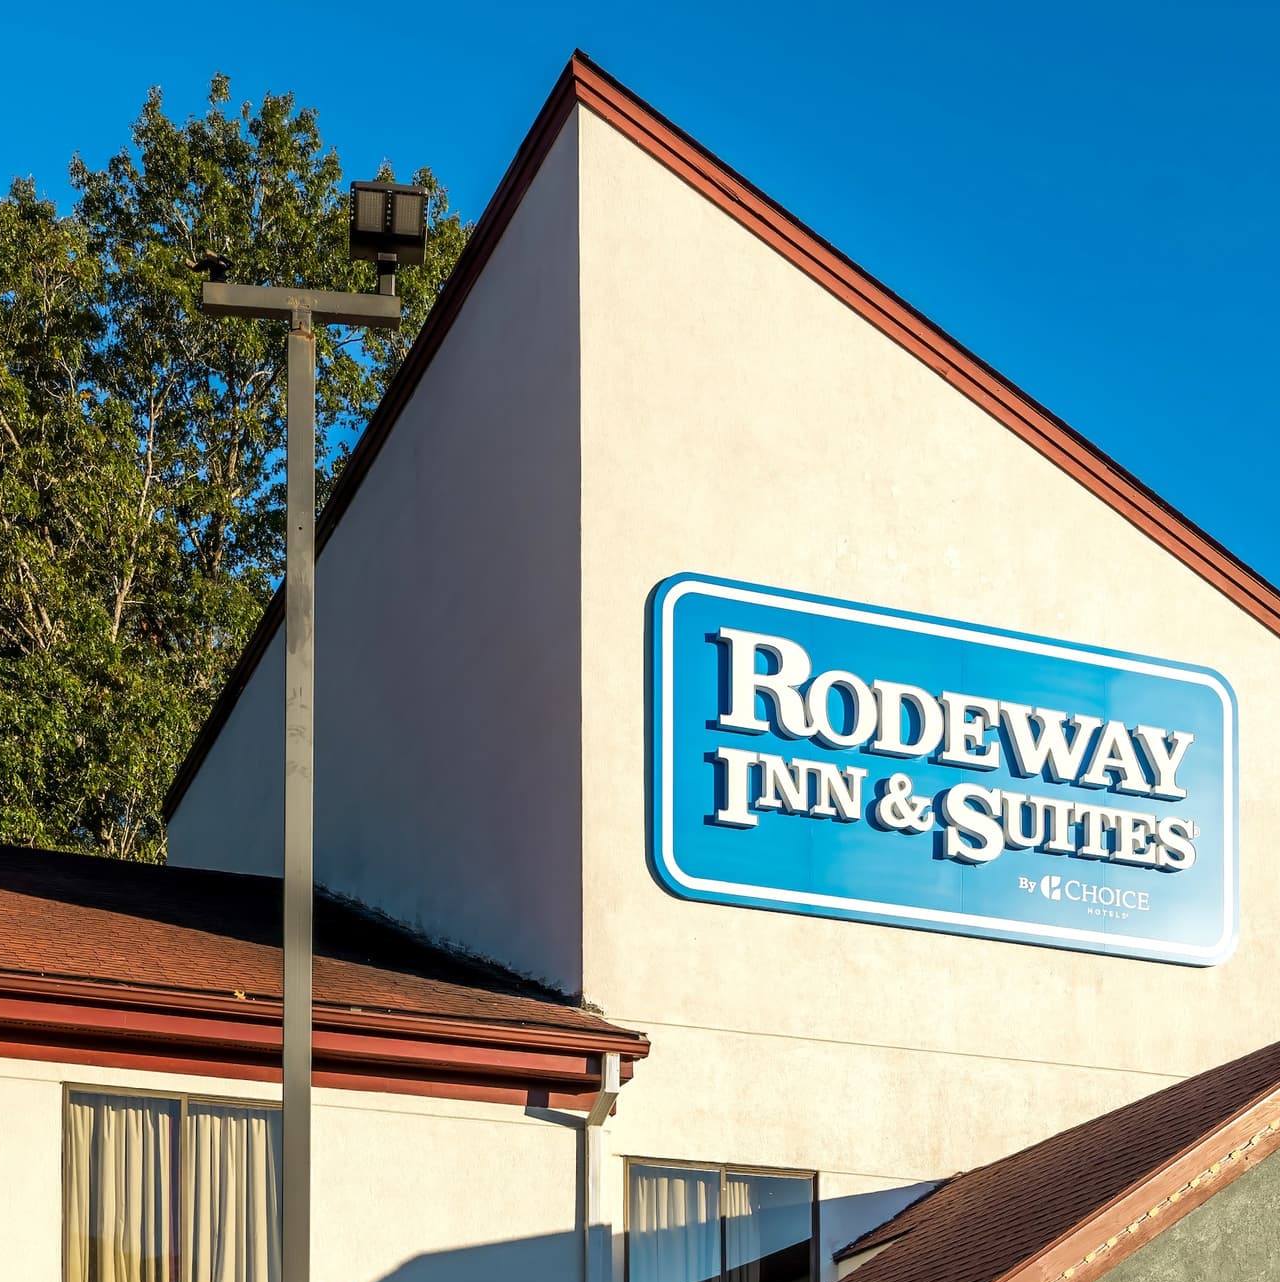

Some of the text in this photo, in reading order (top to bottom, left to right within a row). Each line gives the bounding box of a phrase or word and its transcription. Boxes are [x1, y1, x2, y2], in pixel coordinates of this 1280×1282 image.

[716, 626, 1195, 800] RODEWAY
[715, 746, 1198, 873] INN & SUITES
[1018, 876, 1151, 911] By CHOICE
